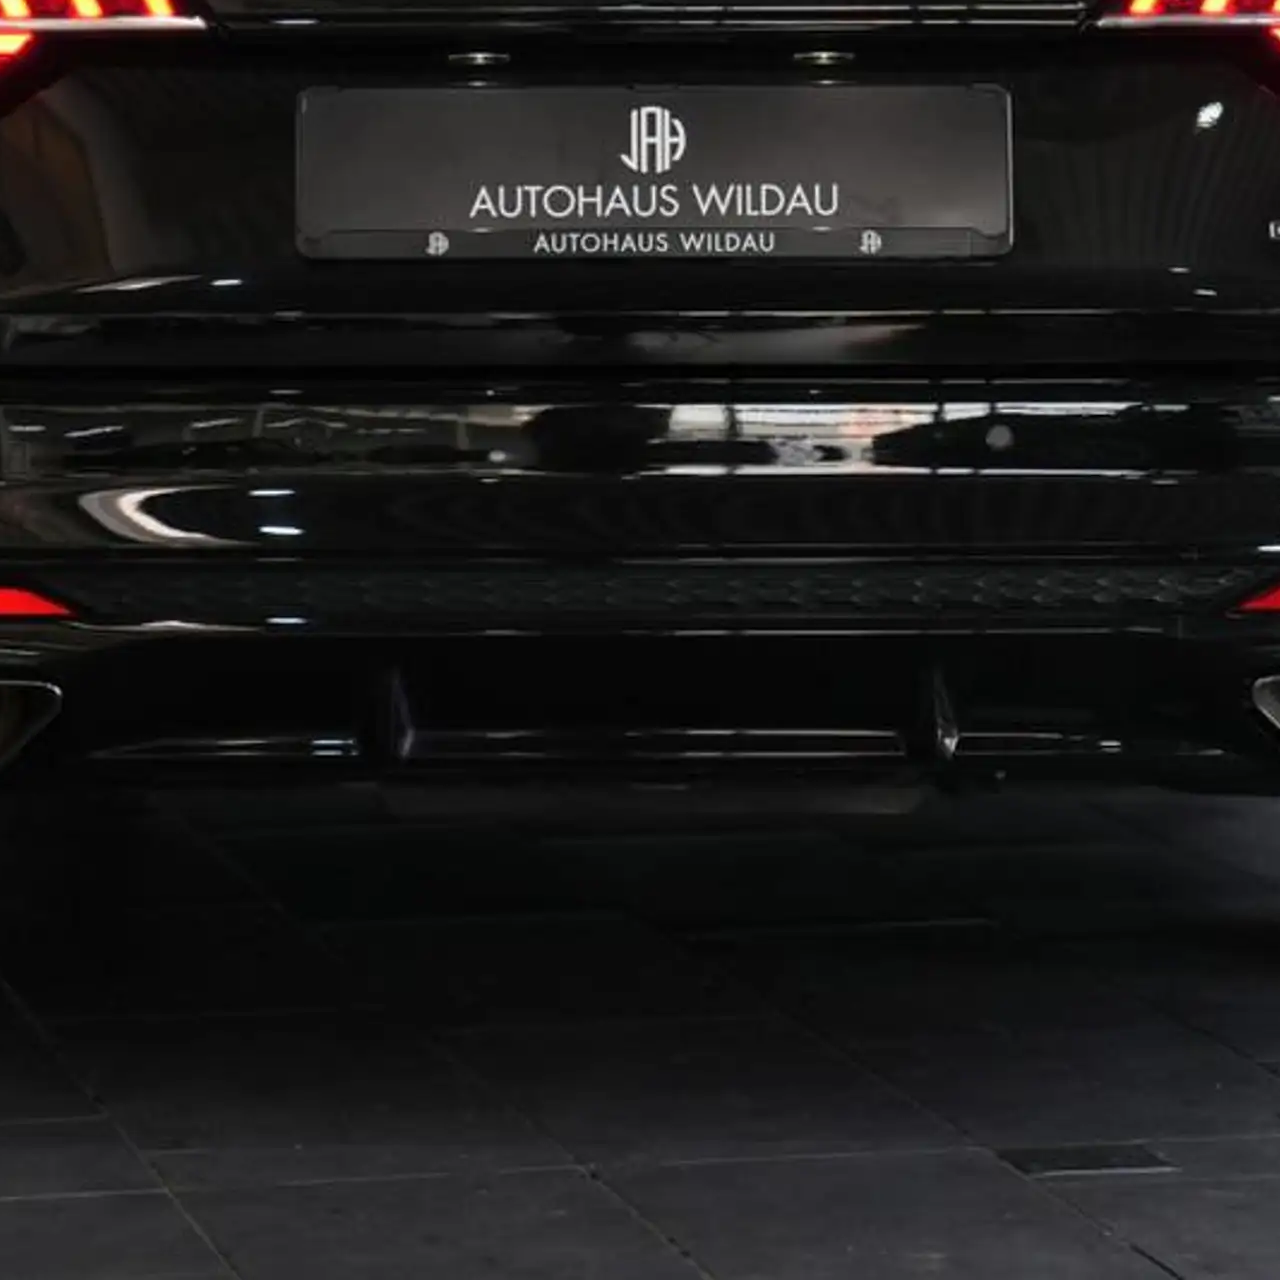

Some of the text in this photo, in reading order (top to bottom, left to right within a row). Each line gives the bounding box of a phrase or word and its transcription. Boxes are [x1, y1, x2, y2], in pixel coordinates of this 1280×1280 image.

[470, 183, 838, 218] AUTOHAUS WILDAU
[534, 233, 775, 253] AUTOHAUS WILDAU
